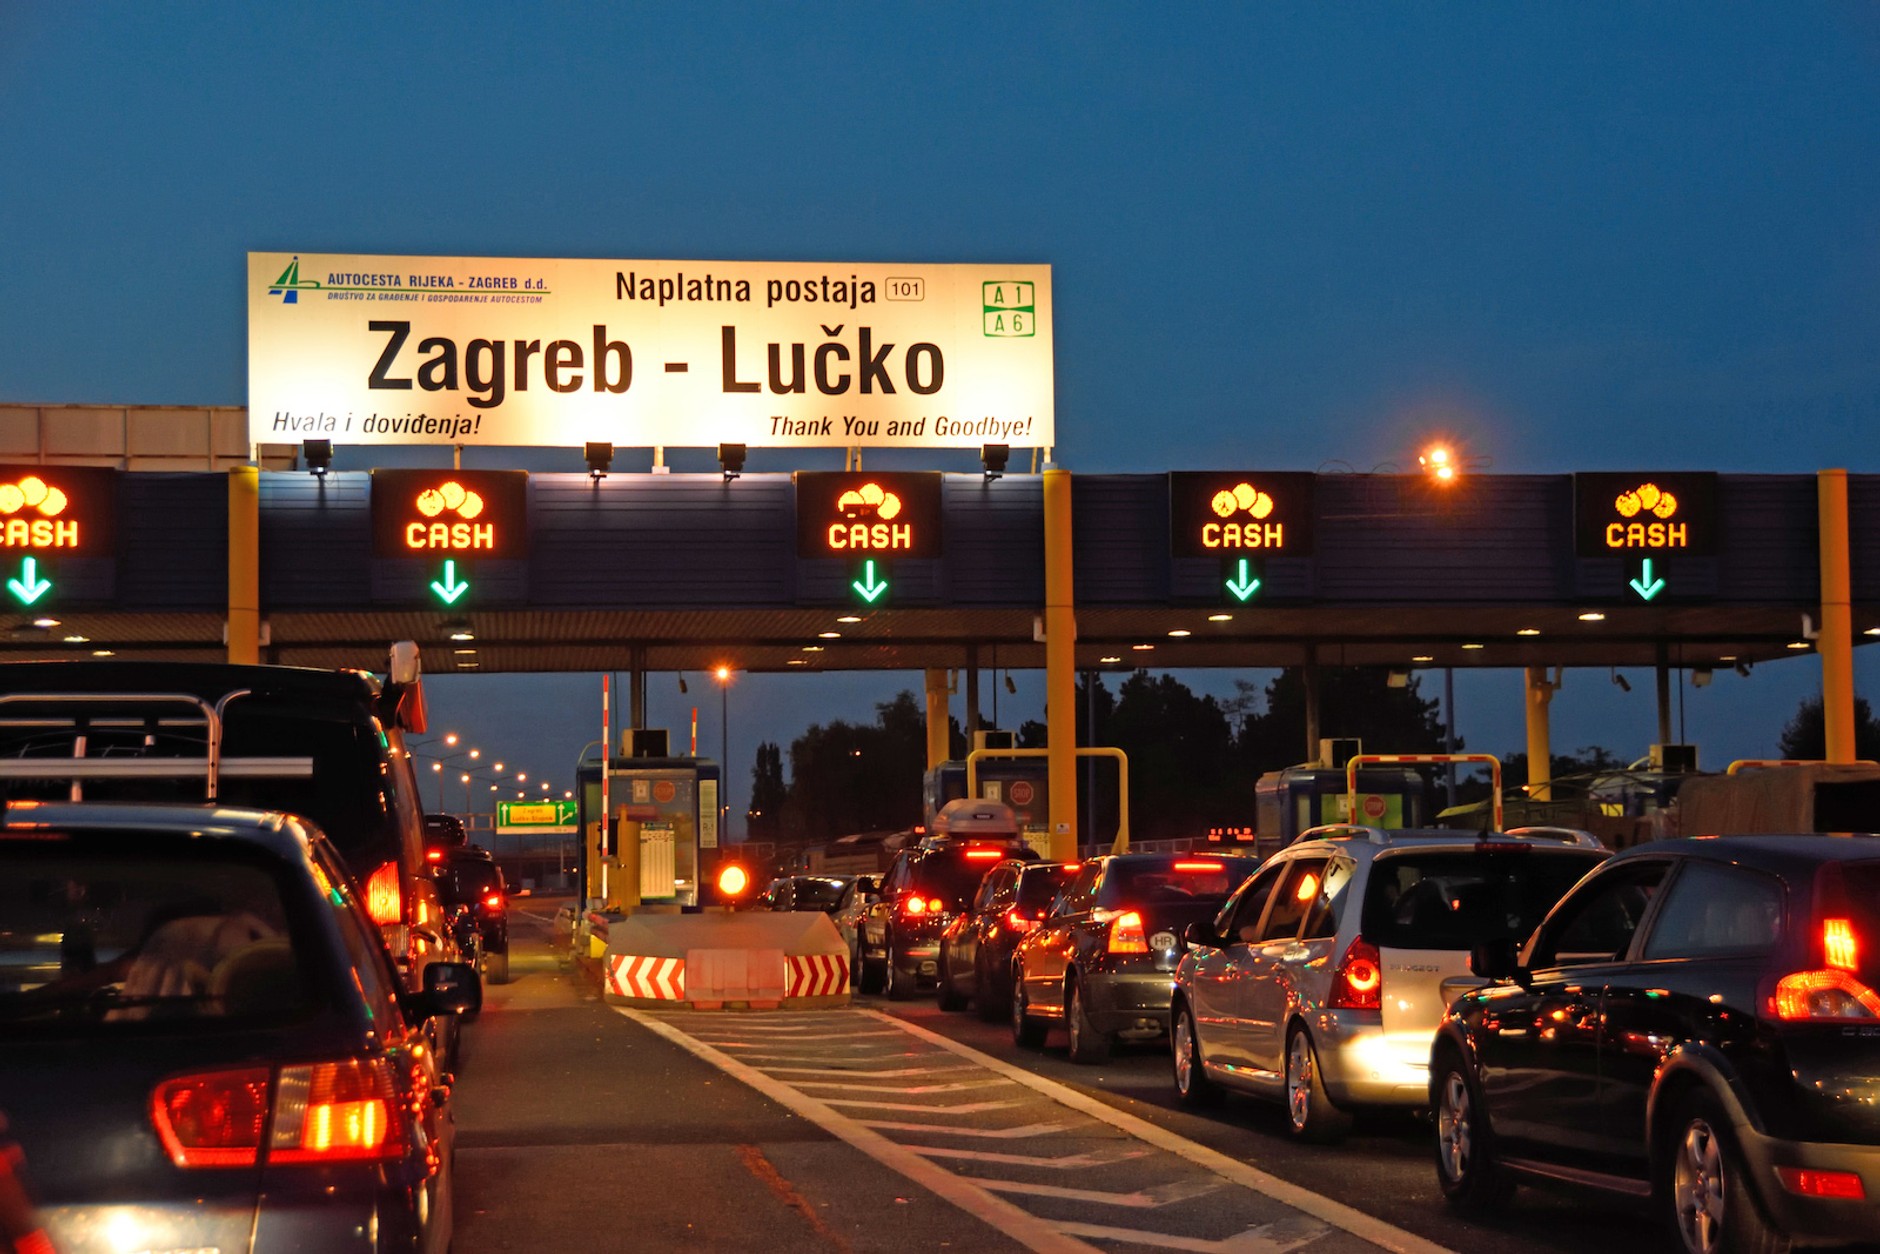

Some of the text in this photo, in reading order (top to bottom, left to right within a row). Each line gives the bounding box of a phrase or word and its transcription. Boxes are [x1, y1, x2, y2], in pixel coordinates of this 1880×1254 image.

[327, 273, 401, 287] AUTOCESTA
[409, 275, 454, 288] RIJEKA
[468, 276, 518, 289] ZAGREB
[524, 278, 548, 290] d.d.
[616, 271, 876, 310] Naplatna postaja
[892, 283, 919, 297] 101
[366, 292, 376, 301] ZA
[427, 294, 488, 304] GOSPODARENJE
[490, 295, 543, 305] AUTOCESTOM
[368, 320, 945, 409] Zagreb - Lučko
[272, 411, 482, 439] Hvala i doviđenja!
[770, 416, 1033, 440] Thank You and Goodbye!
[405, 522, 495, 549] CASH
[828, 523, 912, 549] CASH
[1202, 523, 1283, 549] CASH
[1606, 522, 1687, 549] CASH
[1154, 936, 1172, 946] HR
